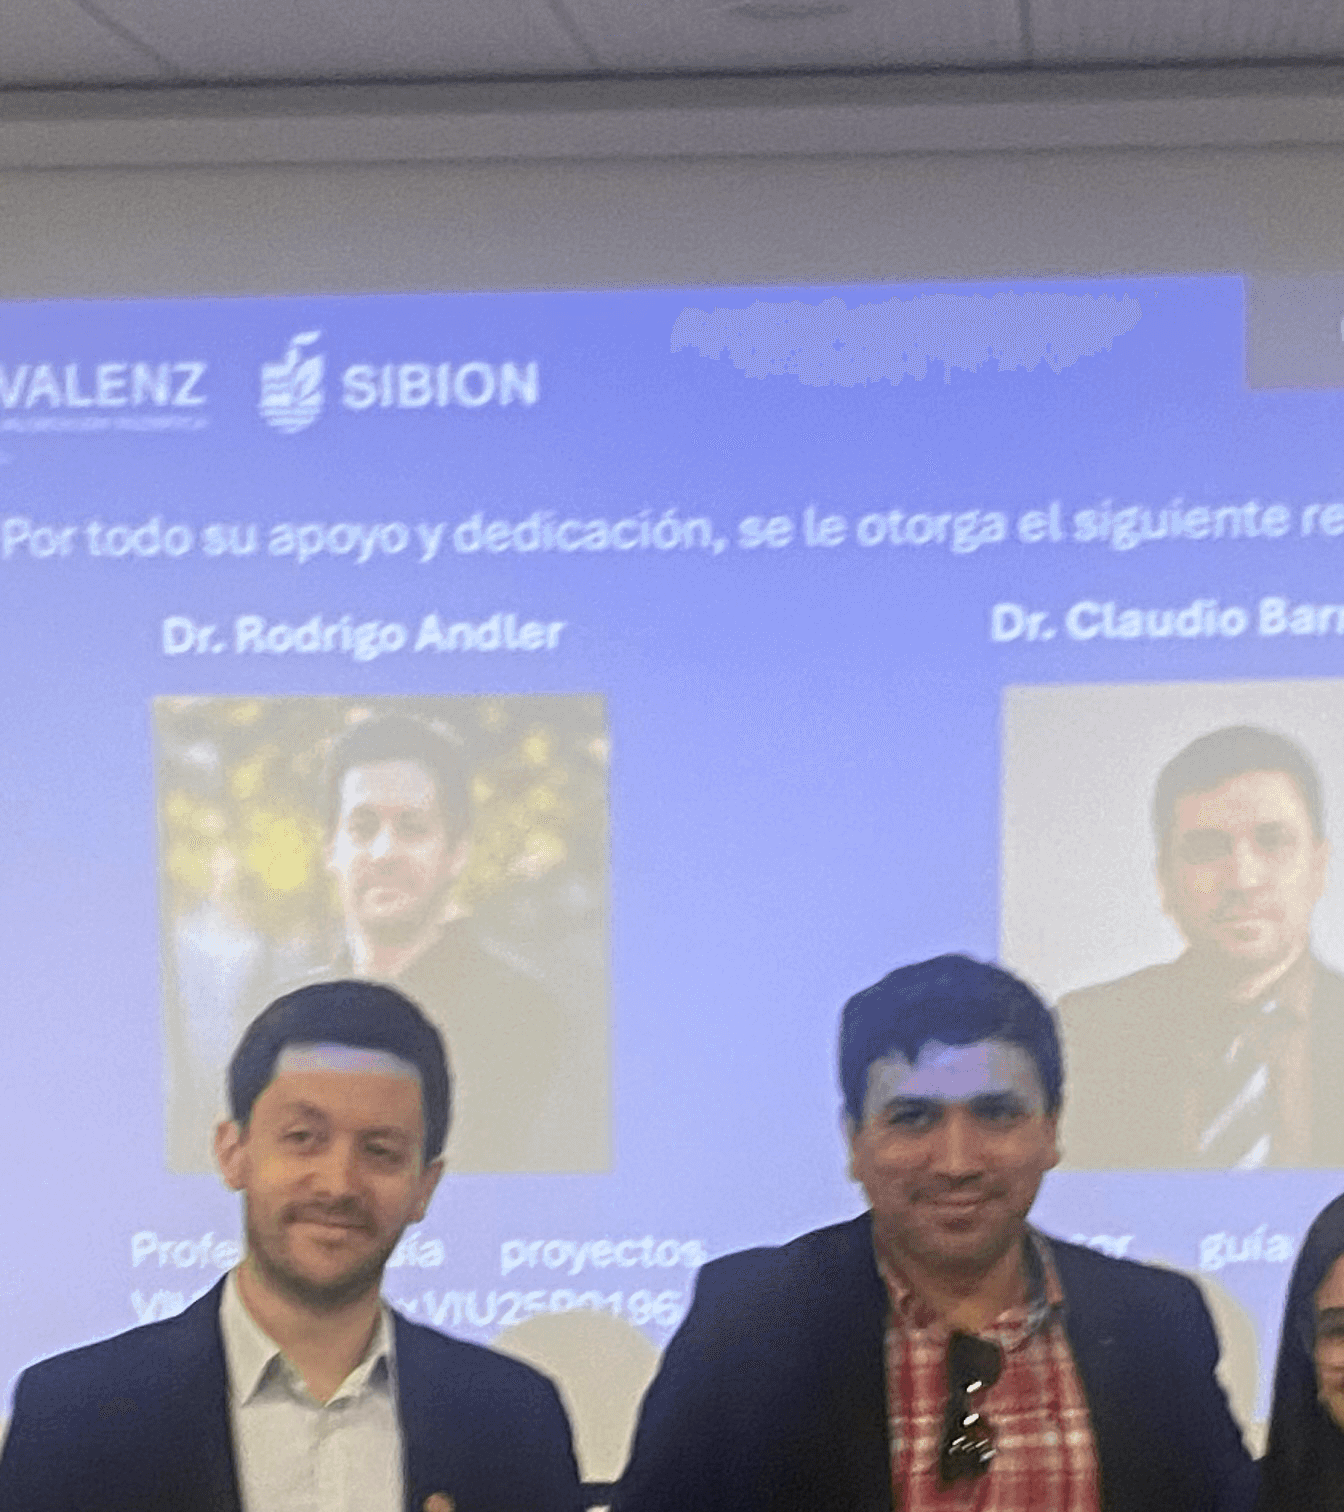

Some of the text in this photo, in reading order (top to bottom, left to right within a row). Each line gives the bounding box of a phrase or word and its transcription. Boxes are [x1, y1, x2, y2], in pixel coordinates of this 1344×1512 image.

[342, 360, 538, 409] SIBION
[2, 515, 78, 559] Por
[86, 515, 193, 557] todo
[202, 521, 256, 556] su
[268, 521, 410, 564] apoyo
[417, 520, 448, 564] y
[454, 507, 728, 555] dedicación,
[738, 514, 794, 549] se
[804, 504, 848, 547] le
[856, 509, 1008, 553] otorga
[1018, 499, 1062, 543] el
[1072, 497, 1291, 552] siguiente
[162, 610, 568, 662] Dr. Rodrigo Andler
[989, 602, 1057, 643] Dr.
[1065, 598, 1250, 640] Claudio
[500, 1234, 707, 1276] proyectos
[1199, 1223, 1294, 1271] guía
